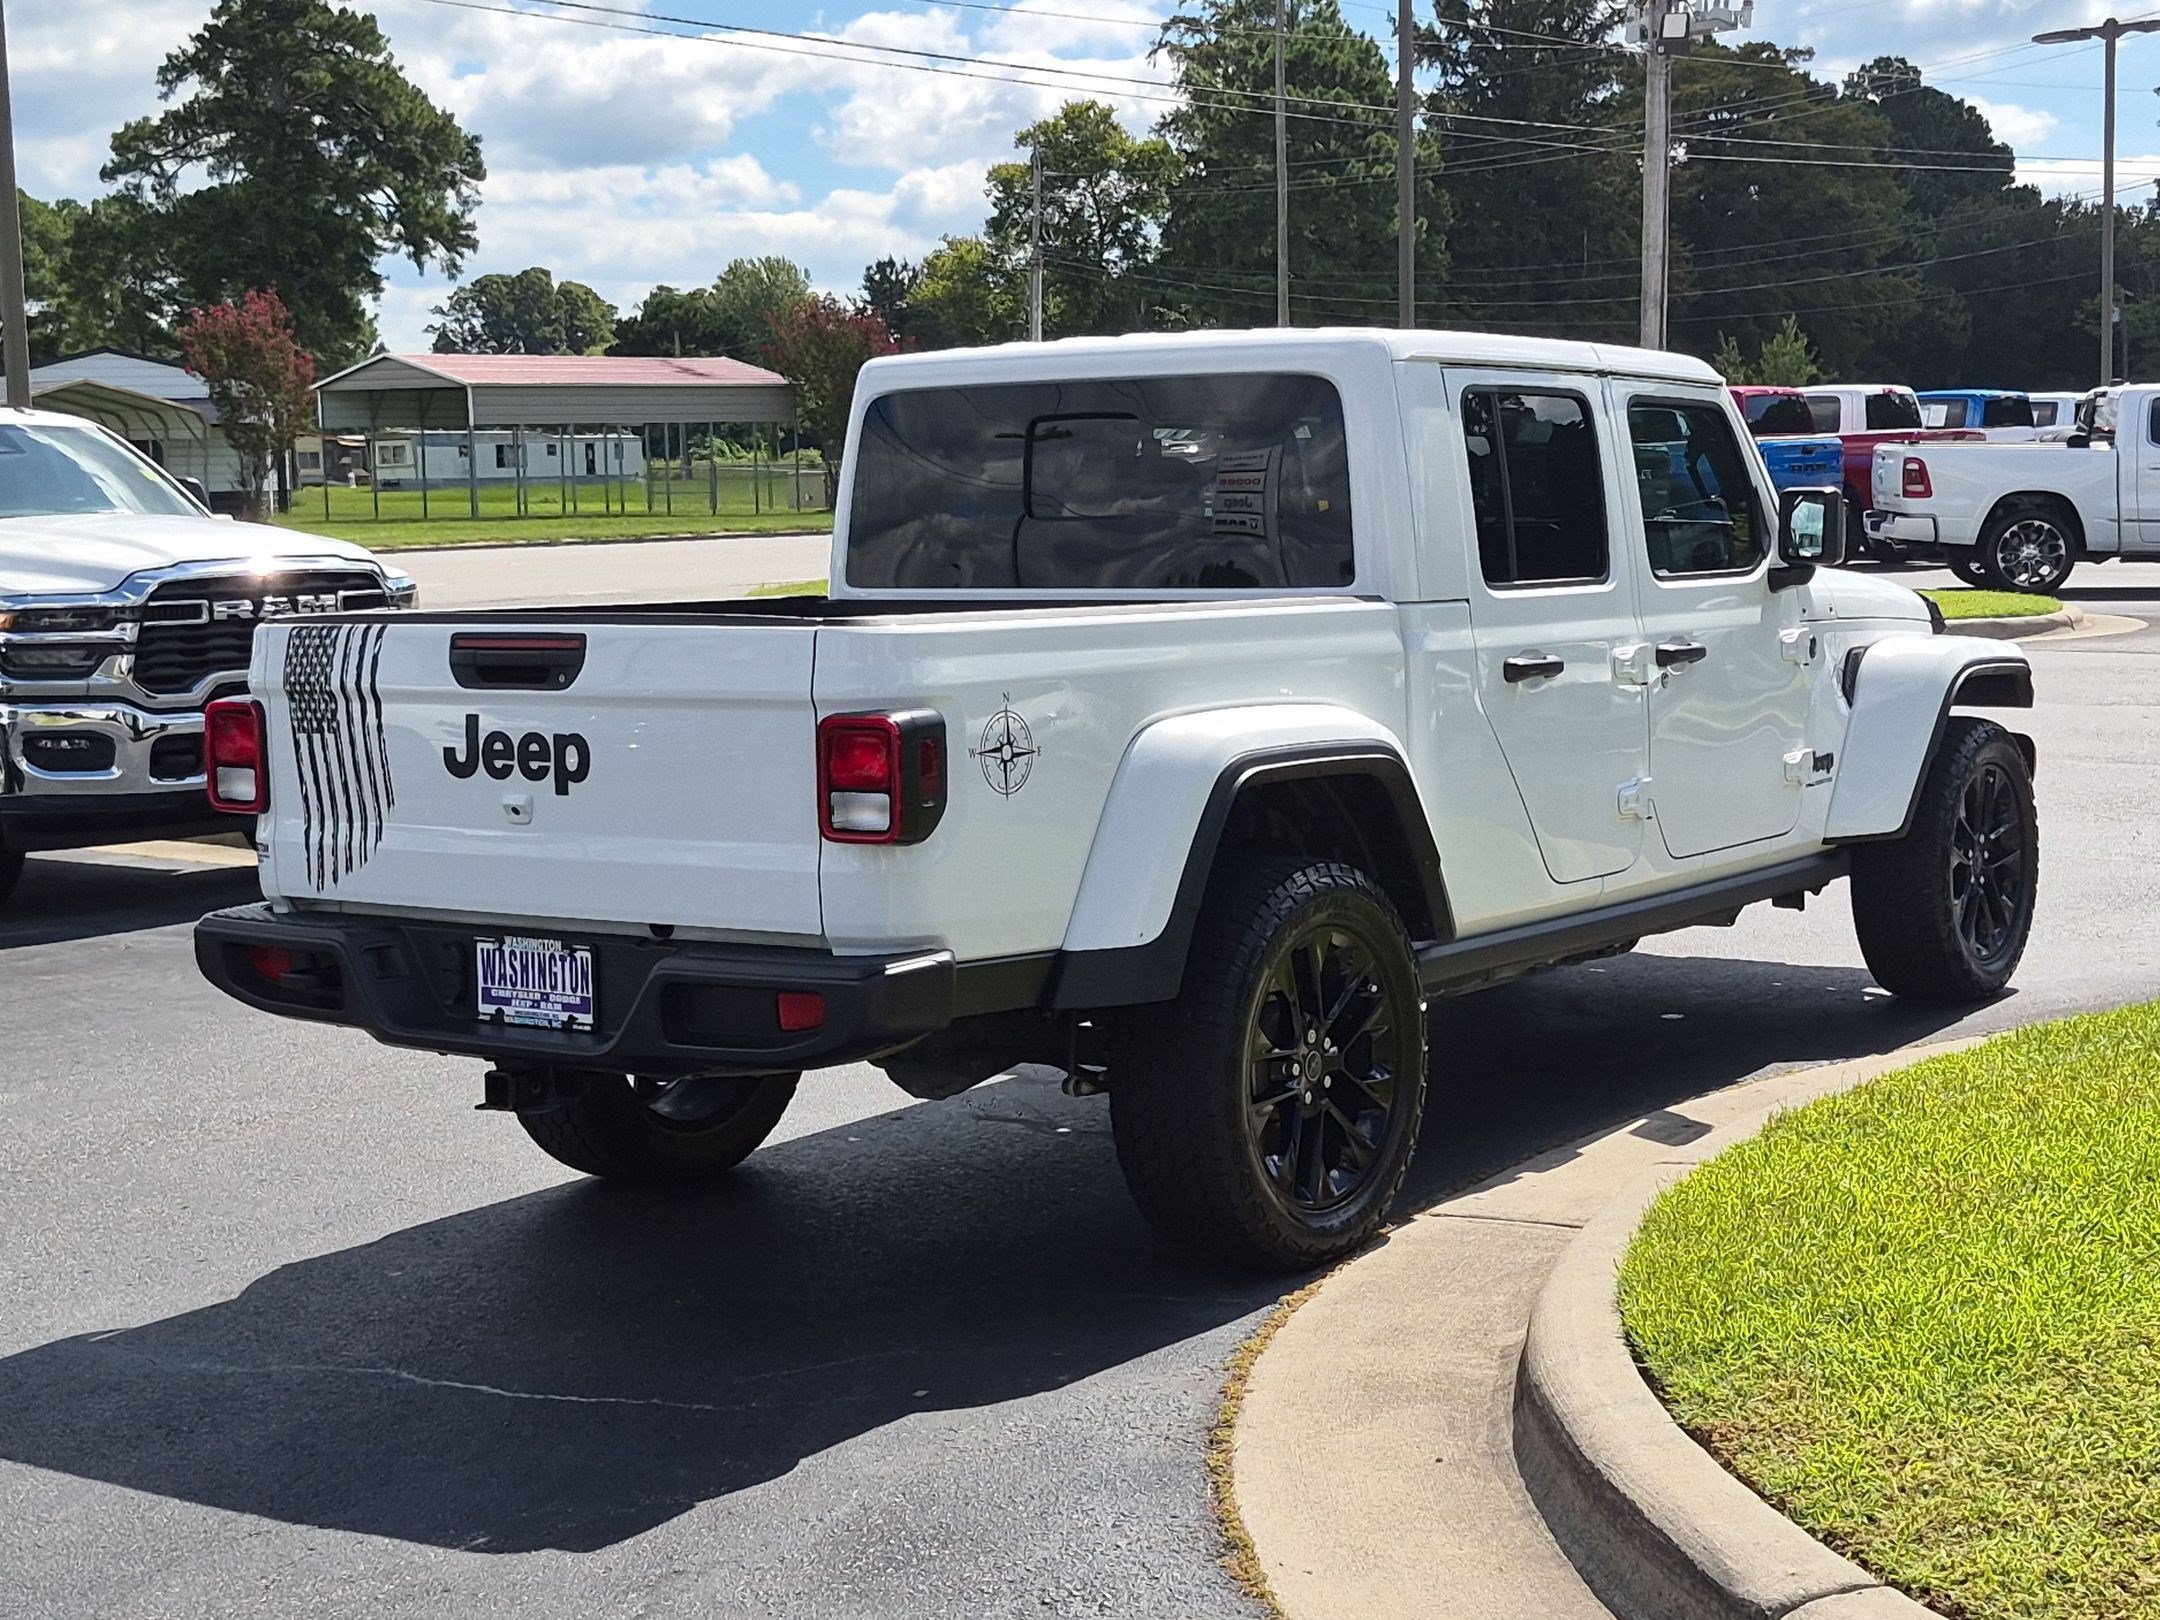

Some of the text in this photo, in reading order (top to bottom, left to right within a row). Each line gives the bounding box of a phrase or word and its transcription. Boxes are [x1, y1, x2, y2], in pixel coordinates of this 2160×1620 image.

[213, 594, 336, 620] RAM
[1002, 691, 1010, 702] N
[443, 713, 590, 796] Jeep
[968, 748, 977, 759] W
[503, 935, 562, 952] WASHINGTON
[480, 947, 590, 995] WASHINGTON
[491, 989, 581, 1005] CHRYSLER DODGE
[511, 999, 562, 1011] JEEP RAM
[504, 1016, 550, 1028] WATON,
